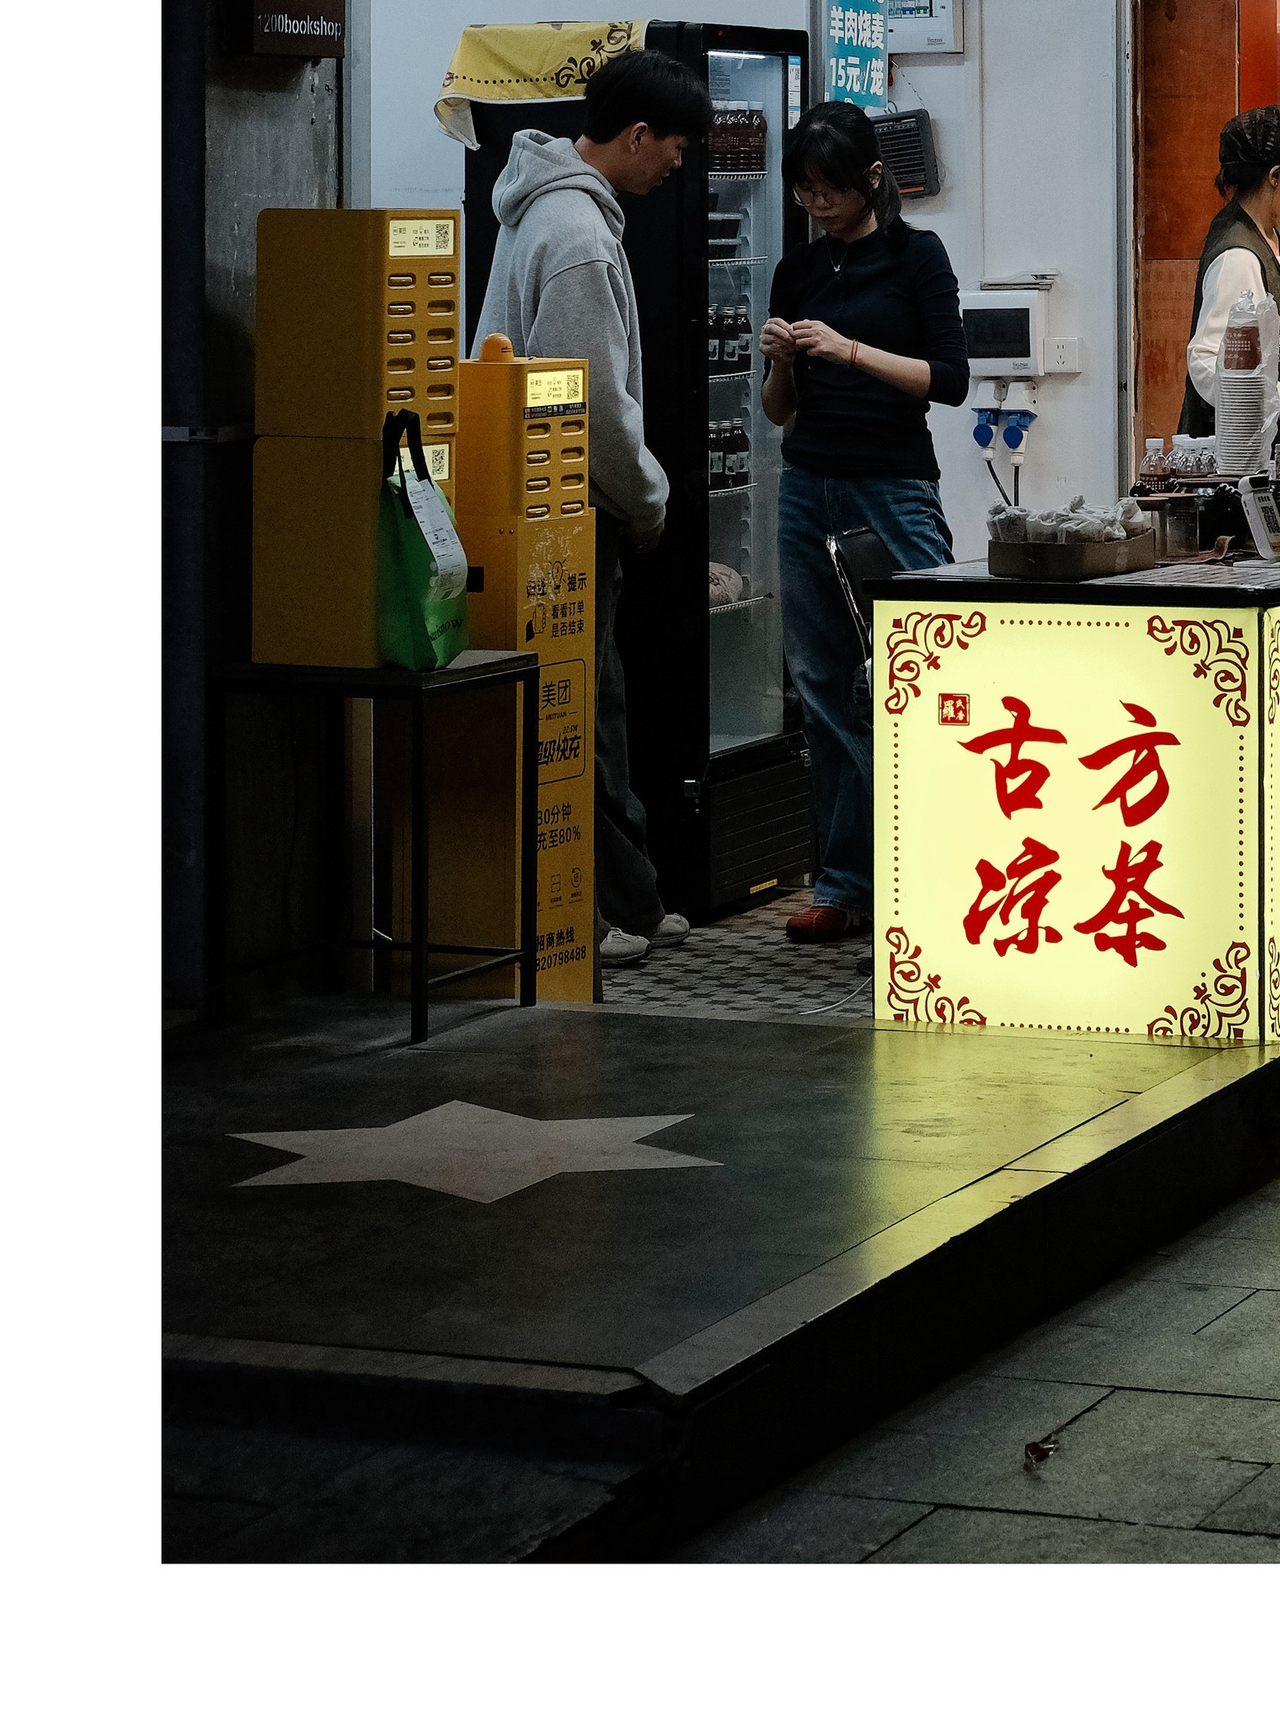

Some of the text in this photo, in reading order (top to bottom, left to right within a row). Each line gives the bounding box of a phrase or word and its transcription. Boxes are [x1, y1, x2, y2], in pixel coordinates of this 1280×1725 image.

[257, 11, 341, 39] 1200bookshop
[829, 6, 885, 50] 羊肉烧麦
[567, 572, 587, 594] 提示
[551, 602, 585, 621] 看看订单
[551, 619, 585, 638] 是否结束
[541, 678, 571, 708] 美团
[957, 695, 1181, 828] 古方
[962, 837, 1185, 968] 凉茶
